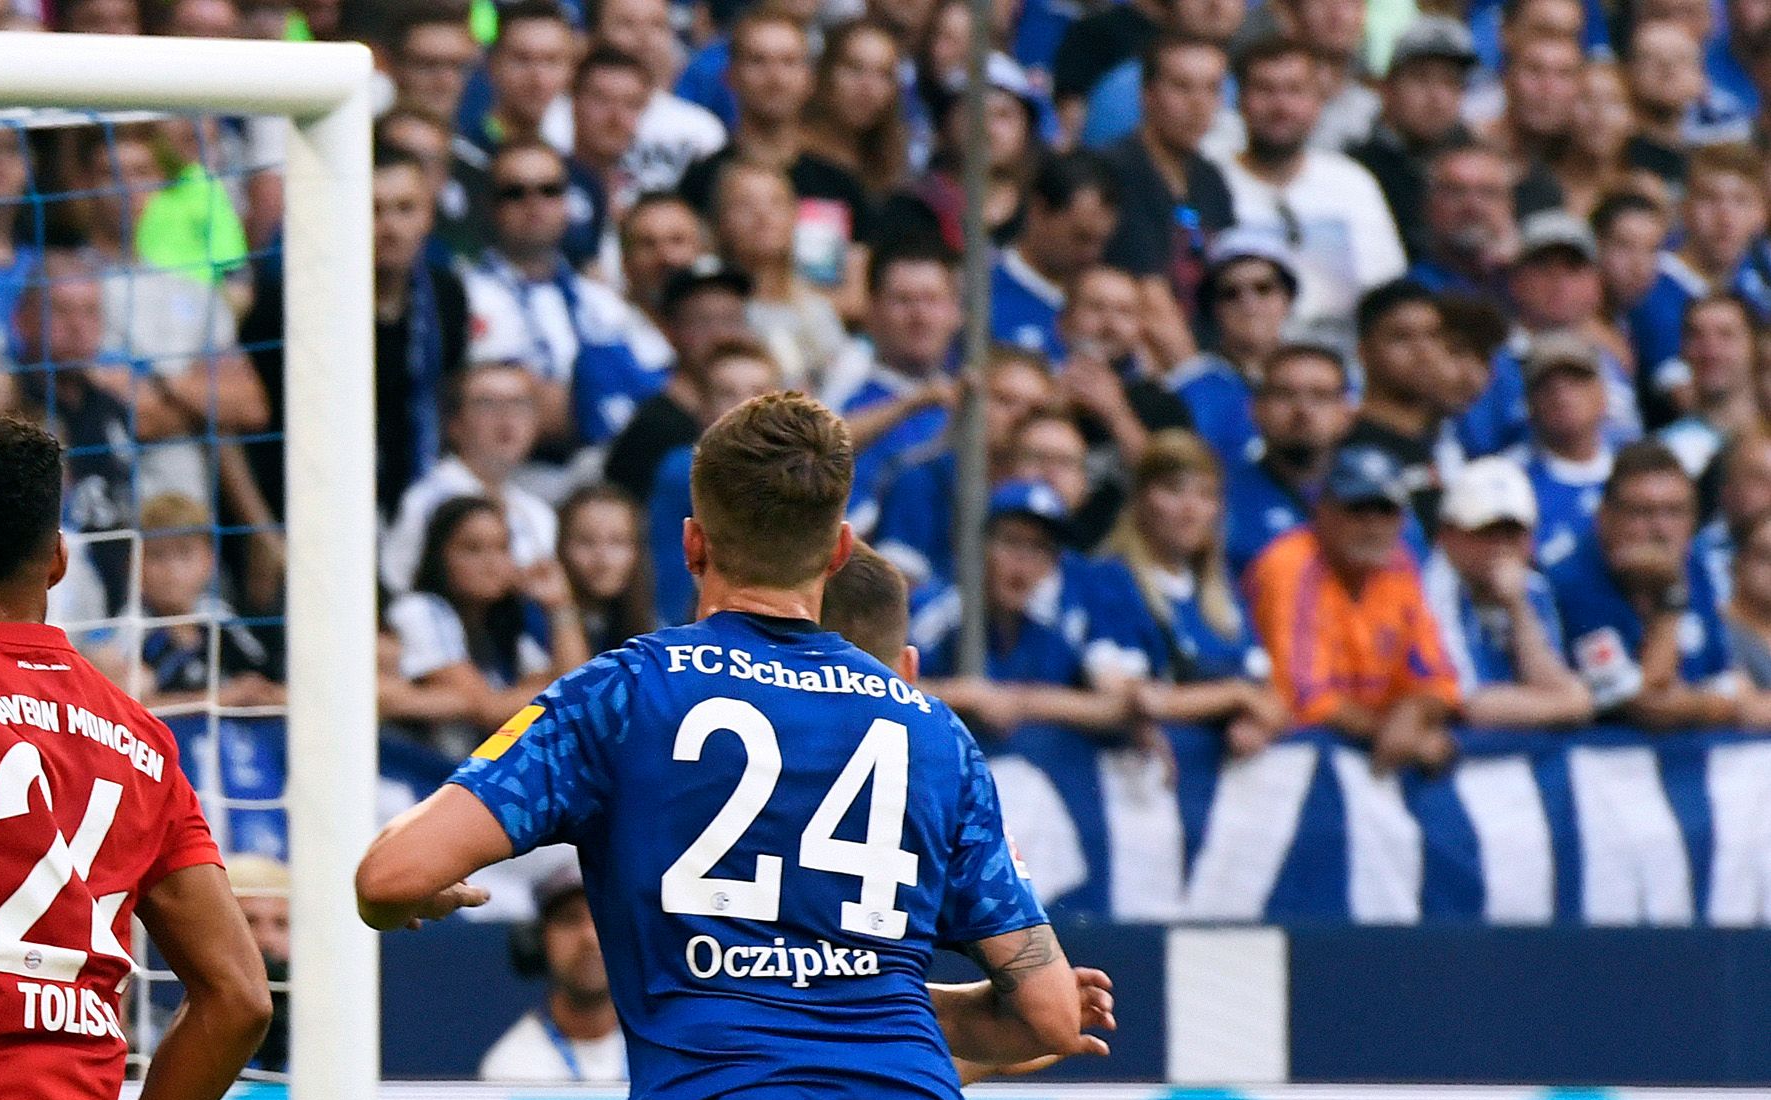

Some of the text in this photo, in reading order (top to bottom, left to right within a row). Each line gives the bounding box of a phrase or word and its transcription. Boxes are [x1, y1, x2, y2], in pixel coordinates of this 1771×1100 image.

[665, 645, 932, 714] FC Schalke 04
[659, 697, 920, 941] 24
[685, 934, 882, 988] Oczipka
